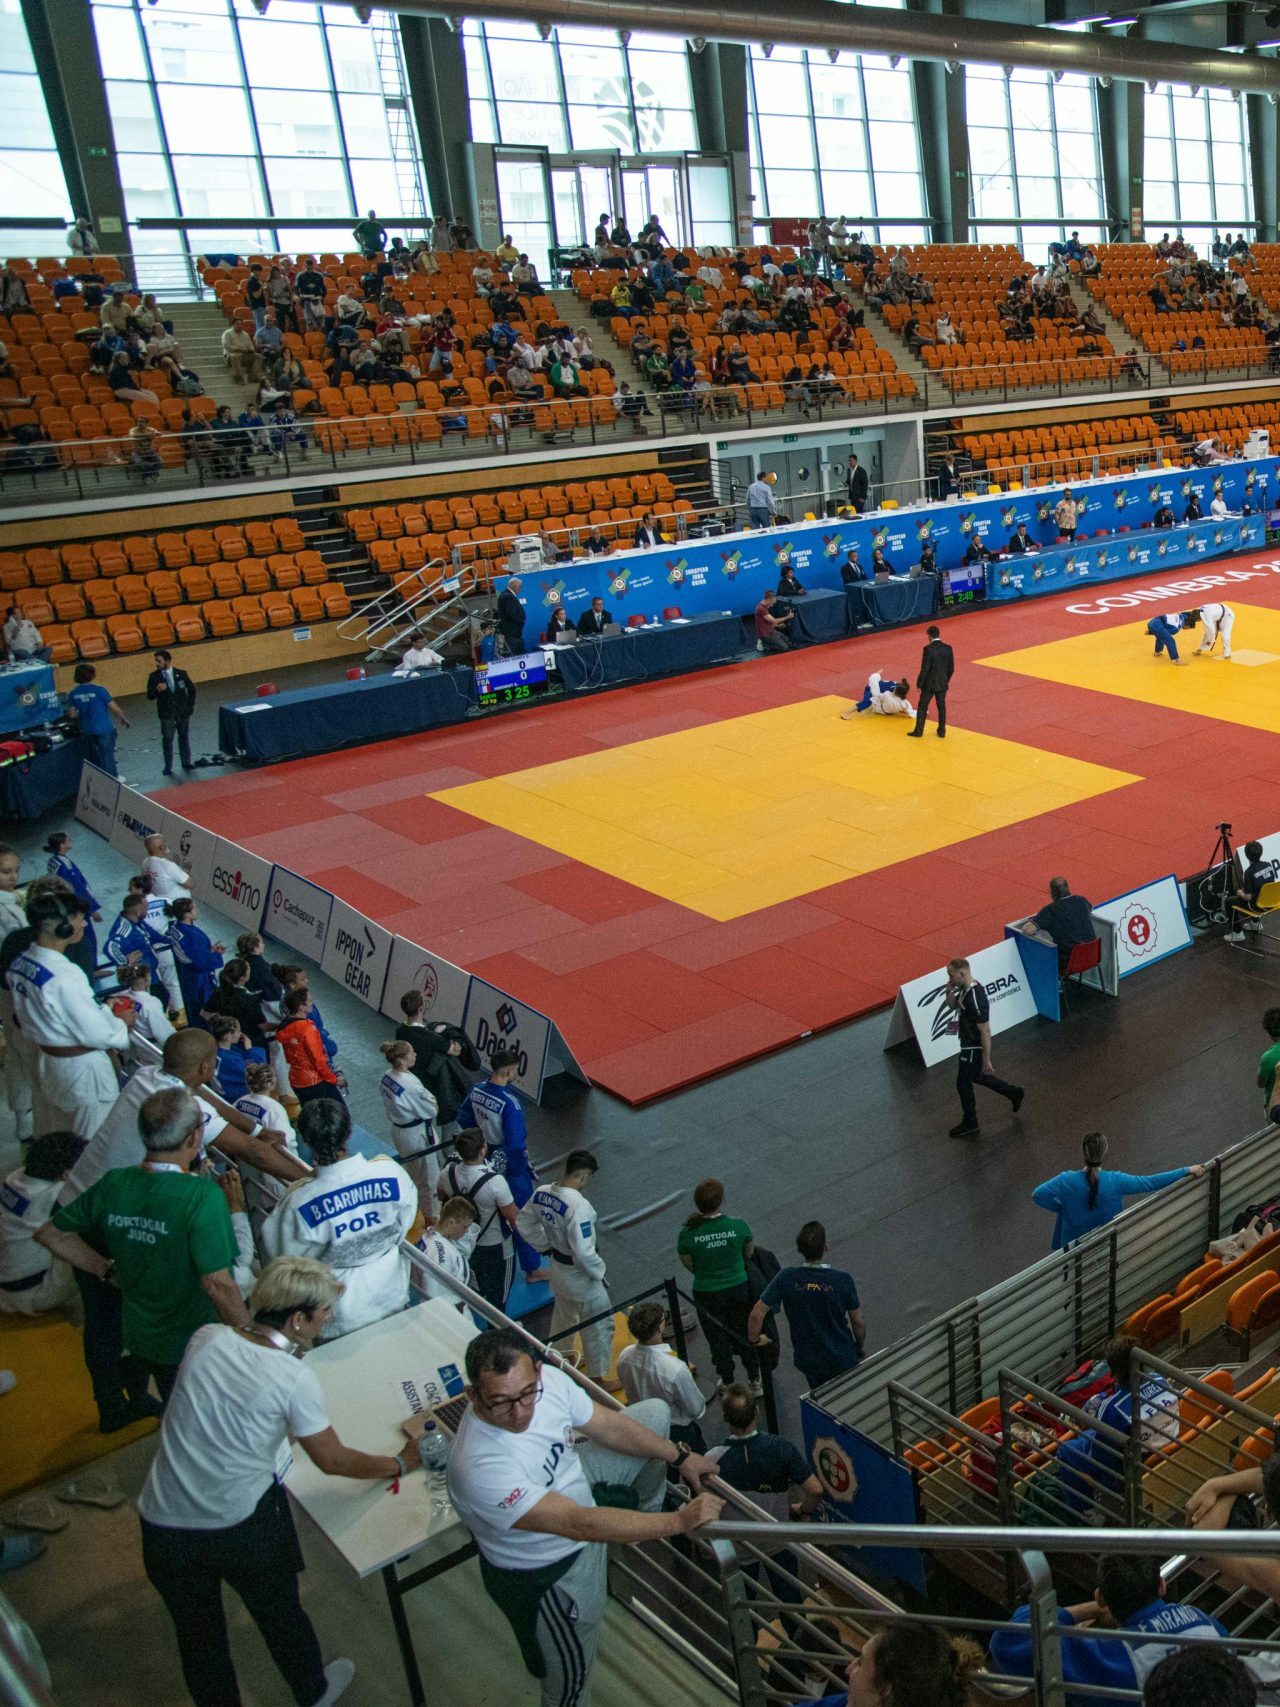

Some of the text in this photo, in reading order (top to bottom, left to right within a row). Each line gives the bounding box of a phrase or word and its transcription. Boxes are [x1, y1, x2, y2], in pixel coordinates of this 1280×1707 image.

[1065, 571, 1268, 615] COIMBRA
[519, 660, 526, 670] 0
[520, 671, 528, 680] 0
[545, 658, 553, 668] 4
[477, 678, 490, 687] FRA
[213, 866, 261, 912] essimo
[283, 899, 315, 927] Cachapuz
[335, 928, 366, 966] IPPON
[344, 962, 372, 999] GEAR
[311, 1180, 392, 1221] B.CARINHAS
[107, 1213, 169, 1236] PORTUGAL
[127, 1228, 157, 1246] JUDO
[334, 1210, 382, 1239] POR
[694, 1230, 737, 1244] PORTUGAL
[706, 1240, 728, 1249] JUDO
[401, 1380, 425, 1415] ASSISTAN
